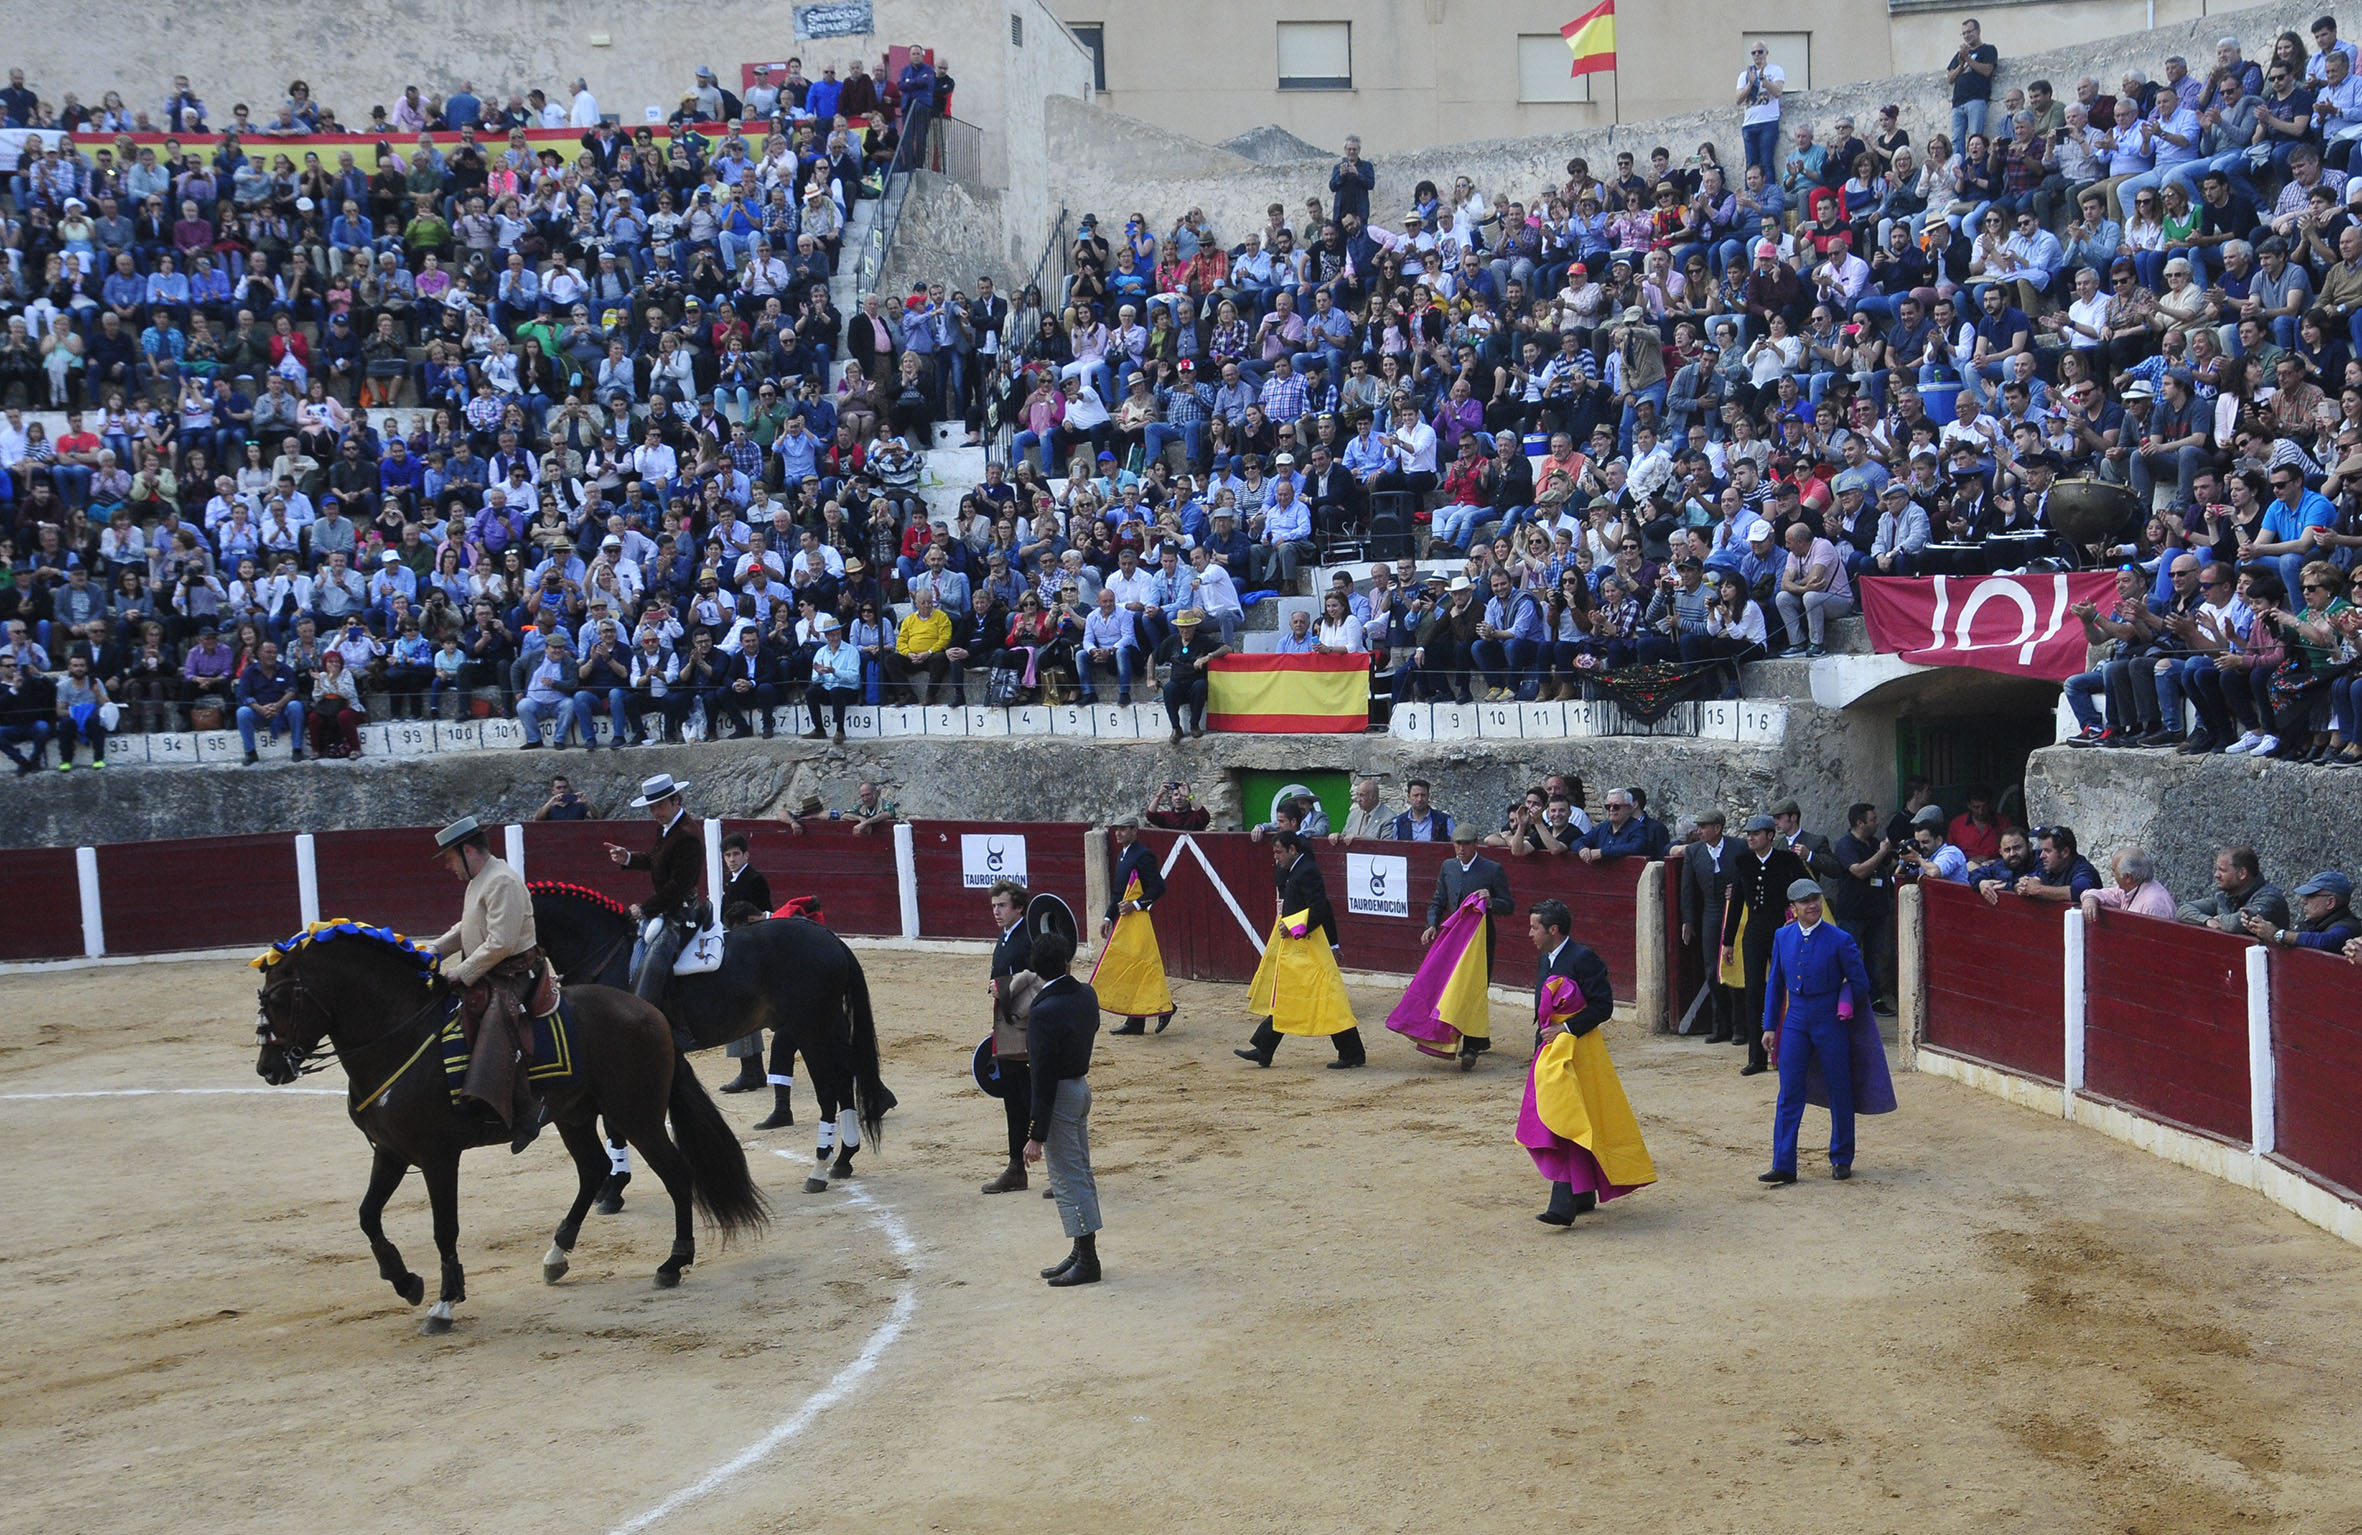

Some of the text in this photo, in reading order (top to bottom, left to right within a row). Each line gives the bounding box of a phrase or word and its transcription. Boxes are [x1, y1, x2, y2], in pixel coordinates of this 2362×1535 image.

[804, 714, 831, 728] 18
[846, 715, 872, 729] 109
[901, 712, 908, 729] 1
[941, 713, 948, 727] 2
[976, 714, 984, 728] 3
[1022, 711, 1031, 725] 4
[1069, 710, 1077, 724] 5
[1109, 712, 1118, 727] 6
[1151, 712, 1159, 726] 7
[1408, 712, 1417, 730] 8
[1451, 713, 1459, 728] 9
[1489, 710, 1506, 726] 10
[1533, 710, 1549, 726] 11
[1574, 707, 1590, 724] 12
[1707, 708, 1725, 725] 15
[1746, 713, 1769, 730] 16
[403, 729, 423, 744] 99
[448, 727, 473, 741] 100
[494, 724, 519, 738] 101
[109, 740, 129, 753] 93
[163, 737, 182, 751] 94
[208, 737, 226, 751] 95
[1349, 897, 1407, 914] TAUROEMOCIÓN
